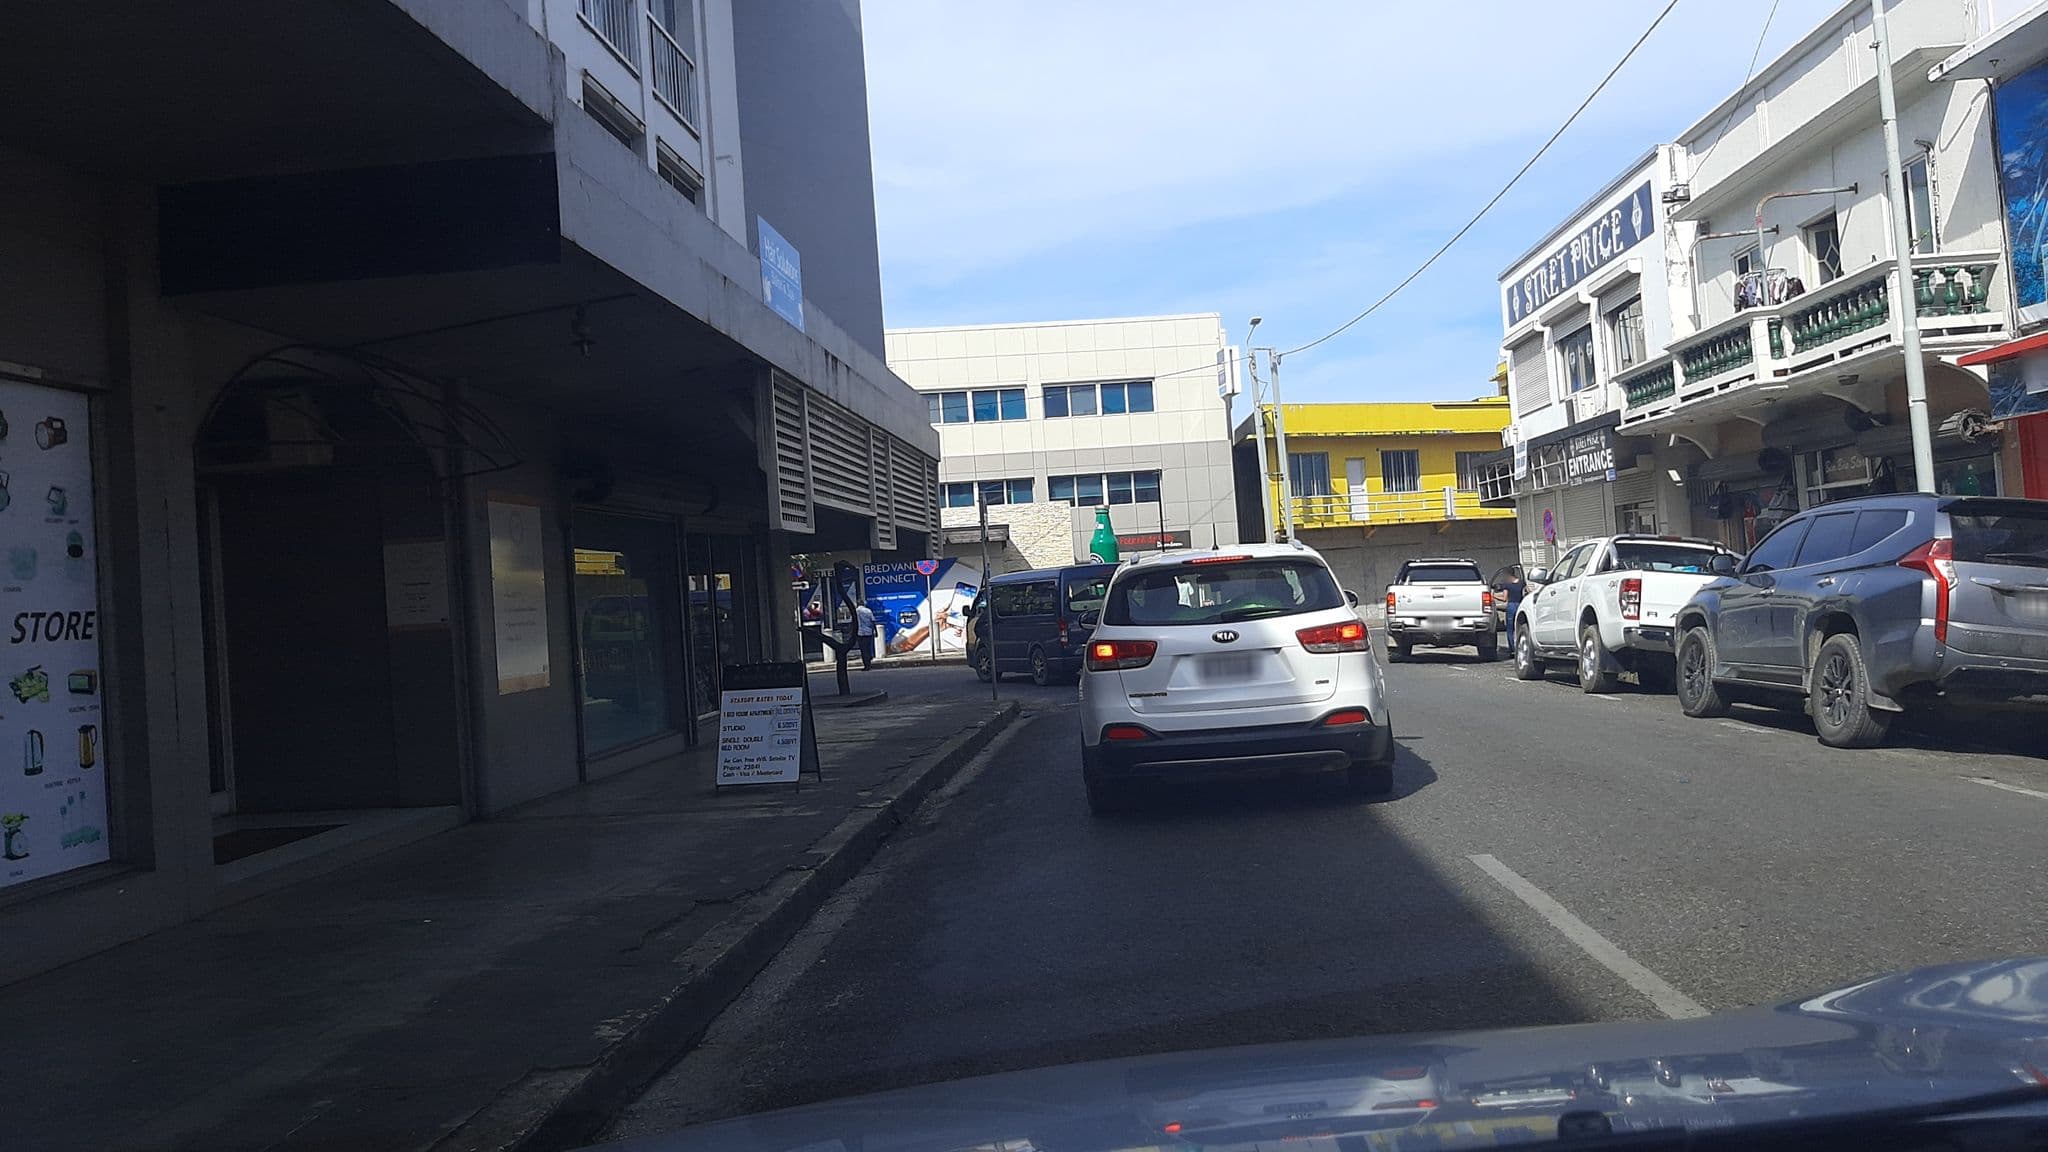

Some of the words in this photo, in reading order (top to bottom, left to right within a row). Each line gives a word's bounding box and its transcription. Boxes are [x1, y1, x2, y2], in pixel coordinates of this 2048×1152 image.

[1569, 209, 1624, 281] PRICE
[1568, 447, 1614, 477] ENTRANCE
[864, 563, 890, 574] BRED
[865, 573, 917, 585] CONNECT
[10, 610, 96, 644] STORE
